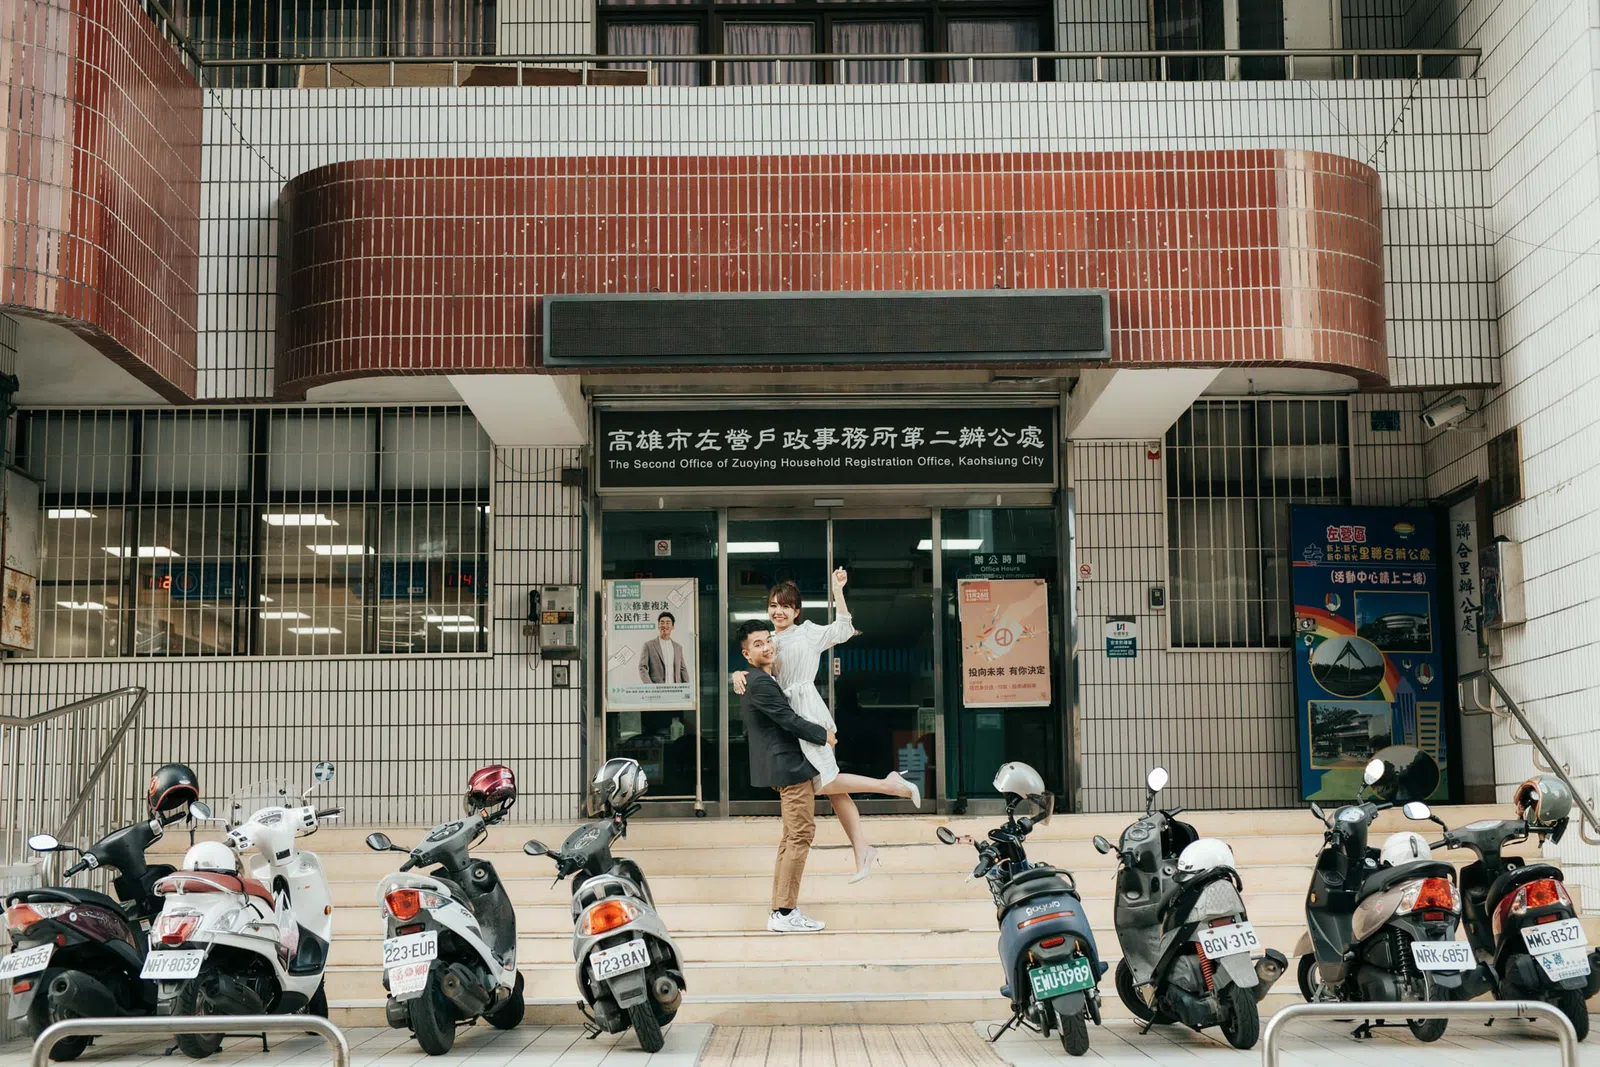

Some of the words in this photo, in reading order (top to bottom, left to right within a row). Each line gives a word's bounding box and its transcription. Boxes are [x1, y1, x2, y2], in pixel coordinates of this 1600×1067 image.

[608, 425, 1045, 452] 高雄市左營戶政事務所第二辦公處
[608, 459, 630, 469] The
[633, 459, 676, 469] Second
[679, 458, 713, 468] Office
[717, 458, 728, 468] of
[732, 458, 777, 470] Zuoying
[781, 457, 841, 468] Household
[845, 457, 913, 469] Registration
[917, 456, 954, 467] Office,
[959, 456, 1018, 468] Kaohsiung
[1022, 456, 1044, 467] City
[1327, 524, 1367, 543] 左營區
[974, 554, 1027, 565] 辦公時間
[1359, 546, 1431, 561] 里聯合辦公處
[1456, 520, 1476, 633] 聯合里辦公處
[614, 601, 669, 611] 首次修憲複決
[614, 612, 651, 622] 公民作主
[968, 667, 1006, 678] 投向未來
[1008, 665, 1046, 676] 有你決定
[1025, 900, 1061, 917] gogoro
